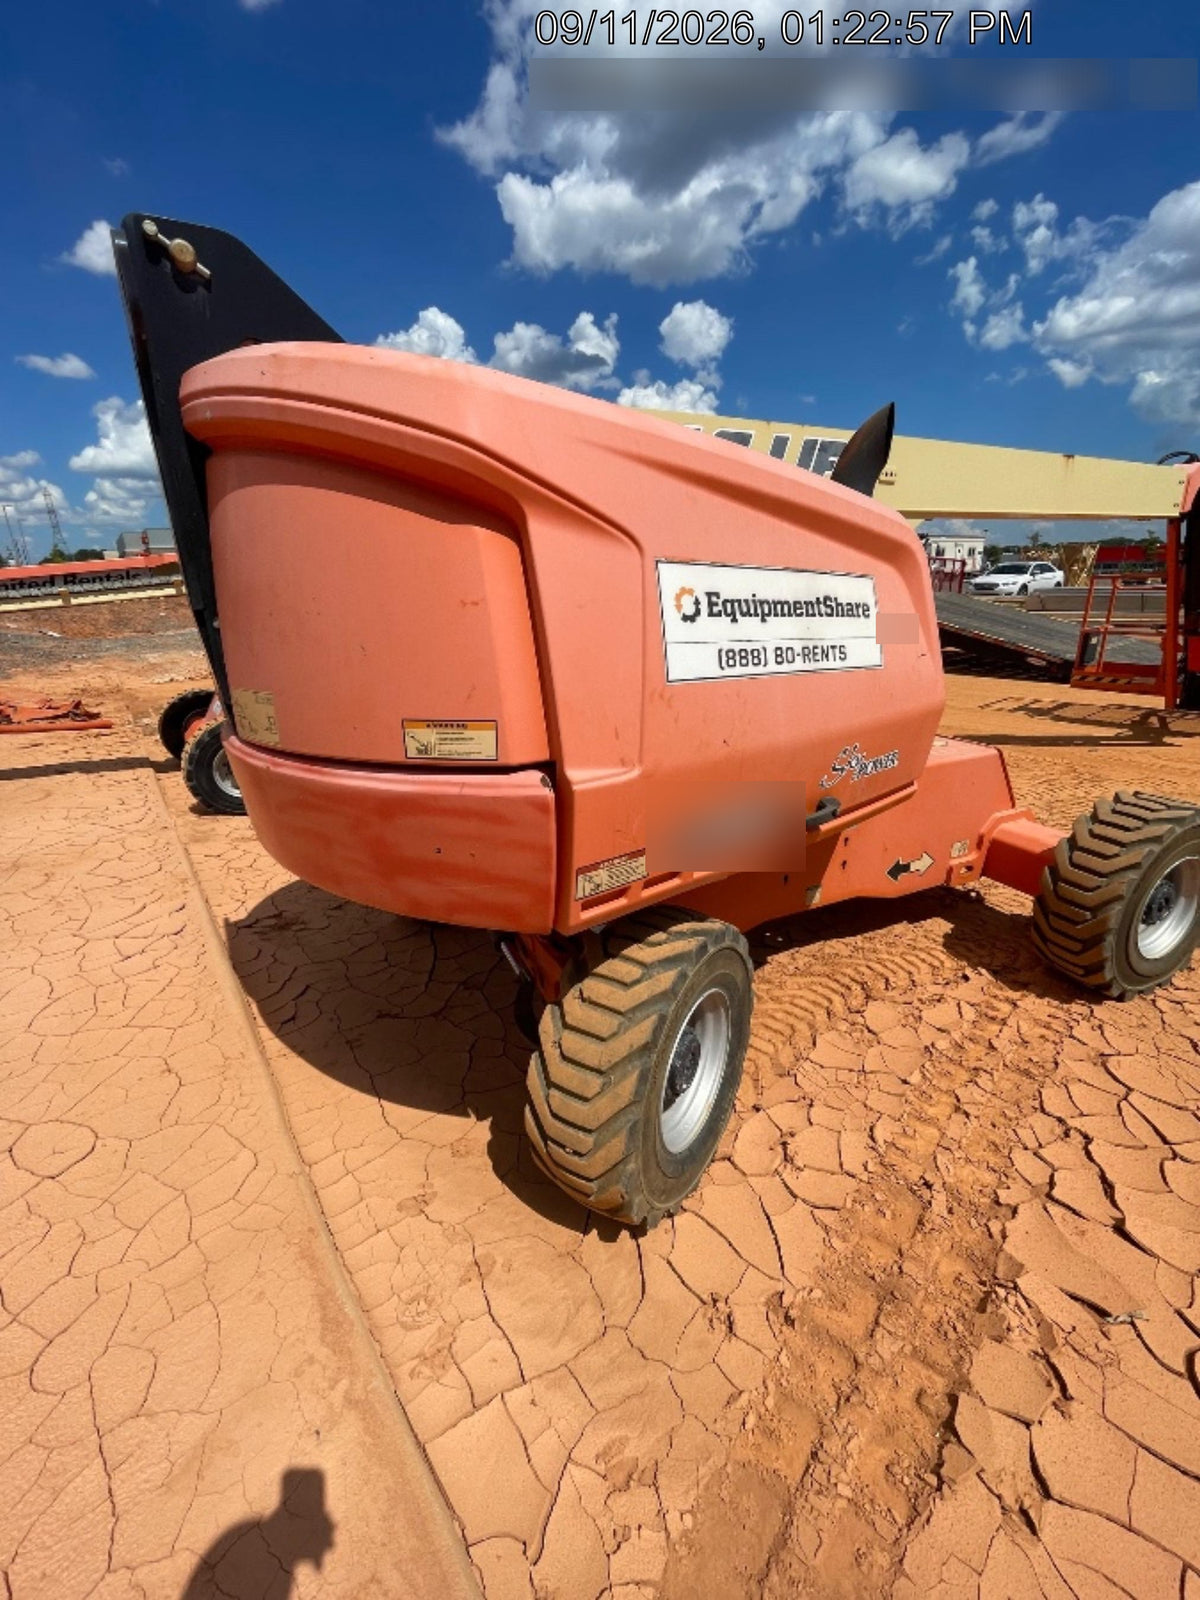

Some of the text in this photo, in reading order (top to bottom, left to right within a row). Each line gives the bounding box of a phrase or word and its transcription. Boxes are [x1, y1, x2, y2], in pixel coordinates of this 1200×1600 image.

[704, 591, 870, 623] EquipmentShare
[717, 645, 848, 671] (888) 80-RENTS
